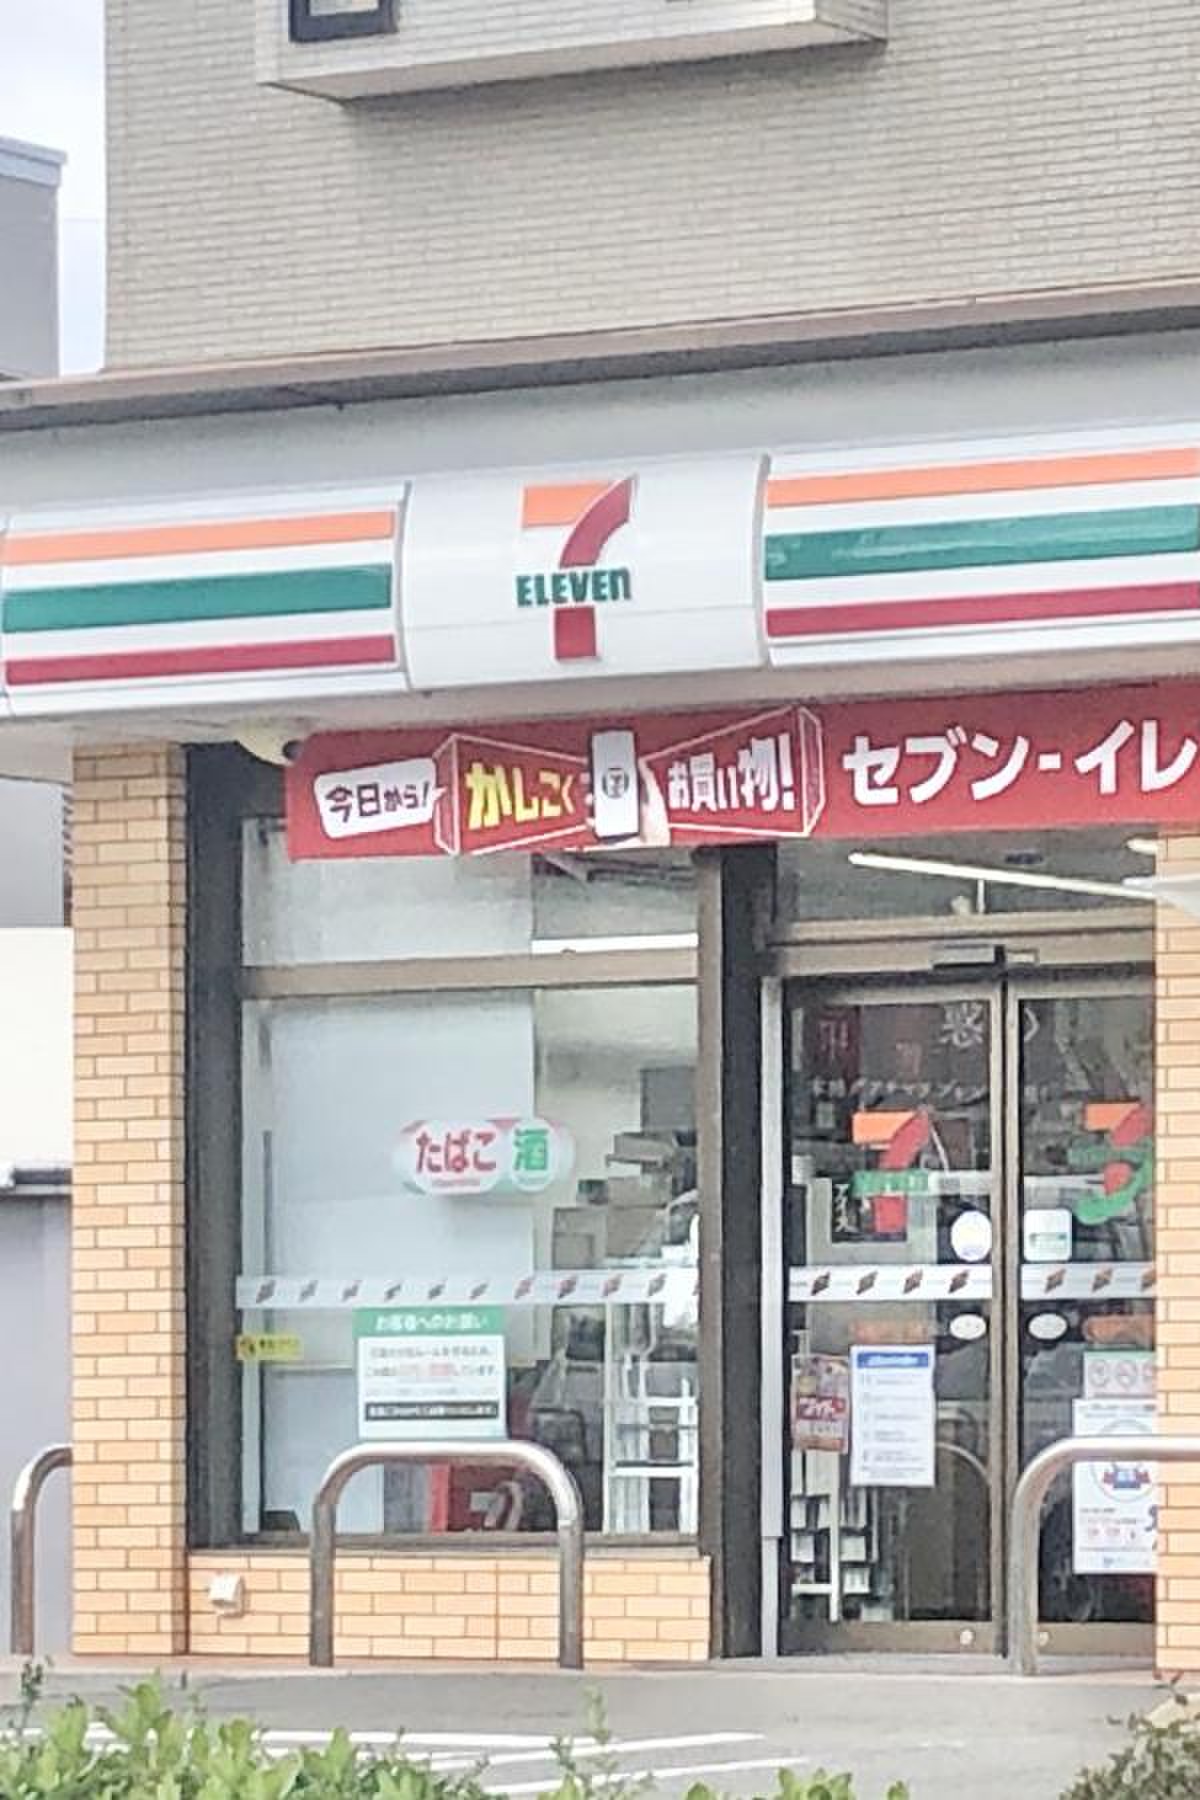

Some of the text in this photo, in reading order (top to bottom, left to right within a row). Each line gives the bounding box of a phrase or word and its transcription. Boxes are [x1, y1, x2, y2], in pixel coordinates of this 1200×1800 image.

[521, 476, 632, 660] 7
[465, 761, 576, 830] かしこく
[667, 732, 795, 813] お買い物!
[415, 1130, 498, 1174] たばこ
